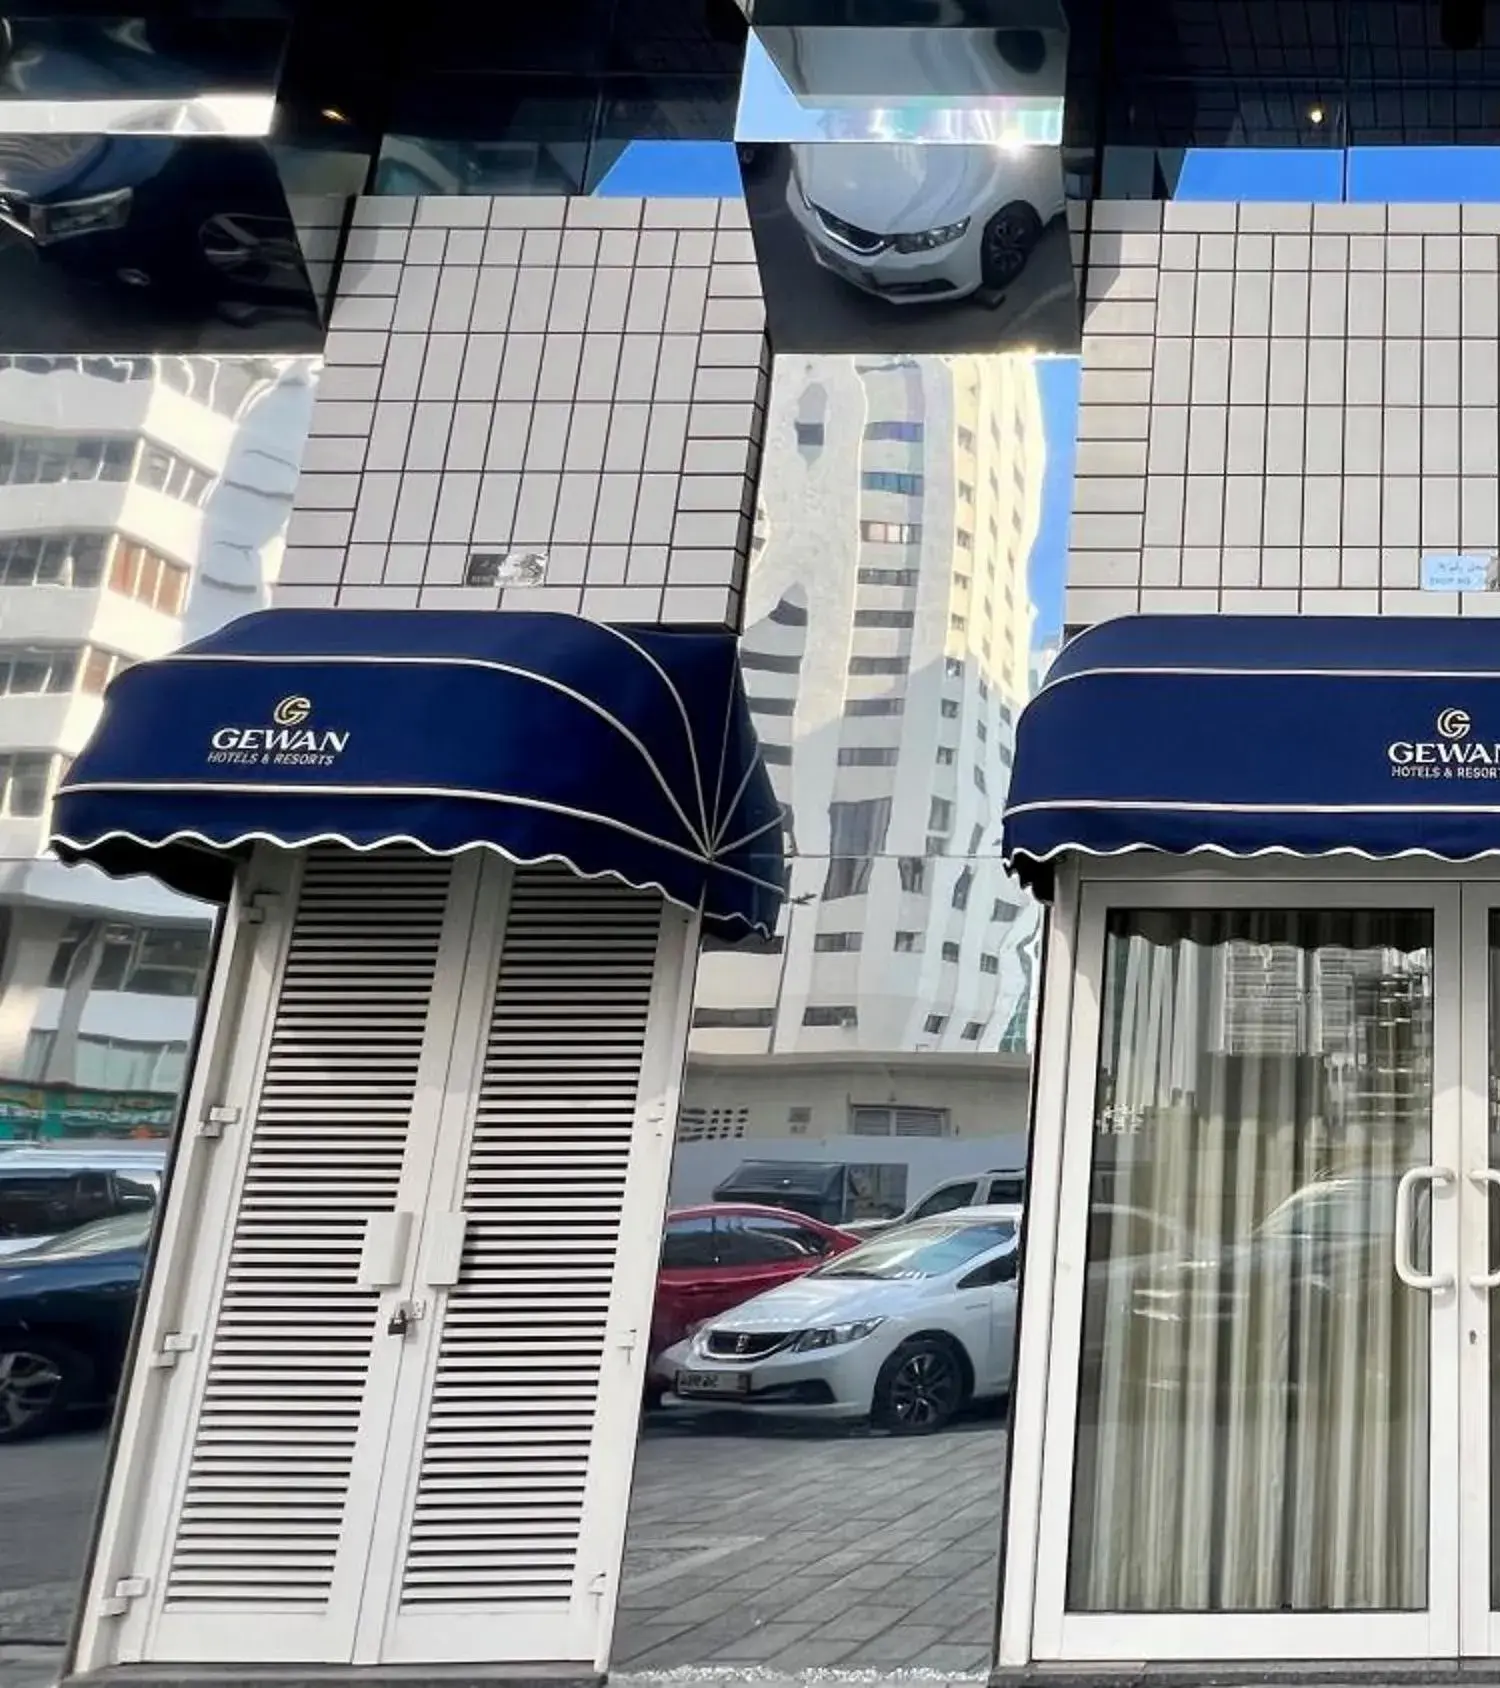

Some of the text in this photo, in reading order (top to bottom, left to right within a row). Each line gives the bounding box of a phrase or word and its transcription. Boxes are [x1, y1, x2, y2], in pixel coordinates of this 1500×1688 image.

[211, 728, 350, 753] GEWAN
[207, 750, 335, 766] HOTELS & RESORTS
[1391, 766, 1441, 779] HOTELS
[1442, 766, 1453, 779] &
